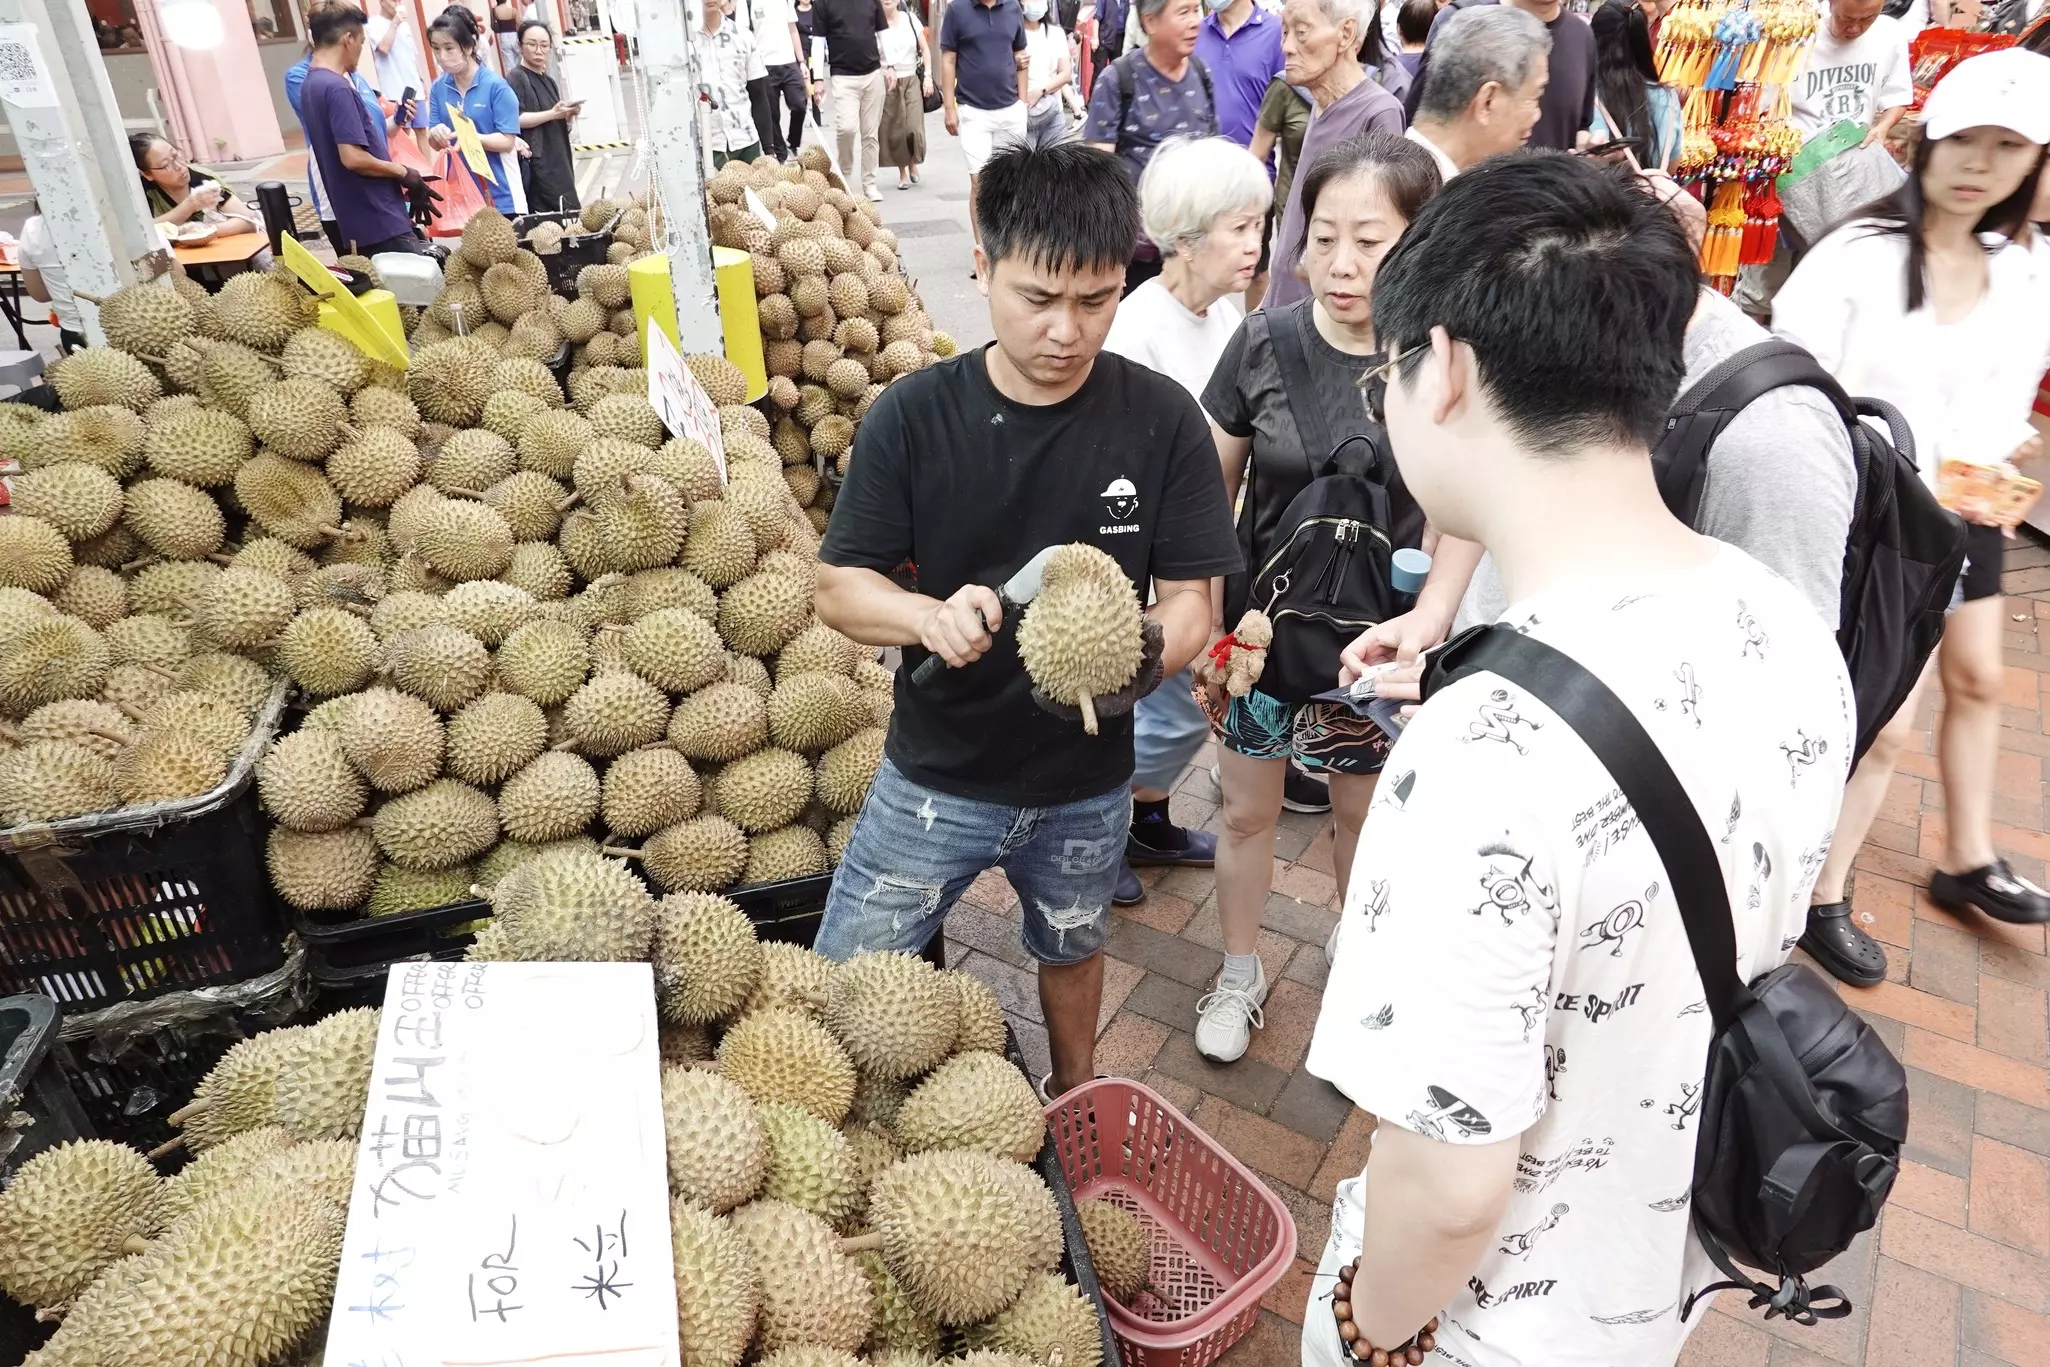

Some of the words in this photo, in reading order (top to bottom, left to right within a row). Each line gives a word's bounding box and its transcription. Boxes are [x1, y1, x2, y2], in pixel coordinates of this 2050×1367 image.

[1806, 62, 1877, 100] DIVISION
[1837, 95, 1850, 114] R
[1099, 524, 1140, 535] GASBING
[401, 961, 428, 1012] OFFER
[431, 961, 458, 1009] OFFER
